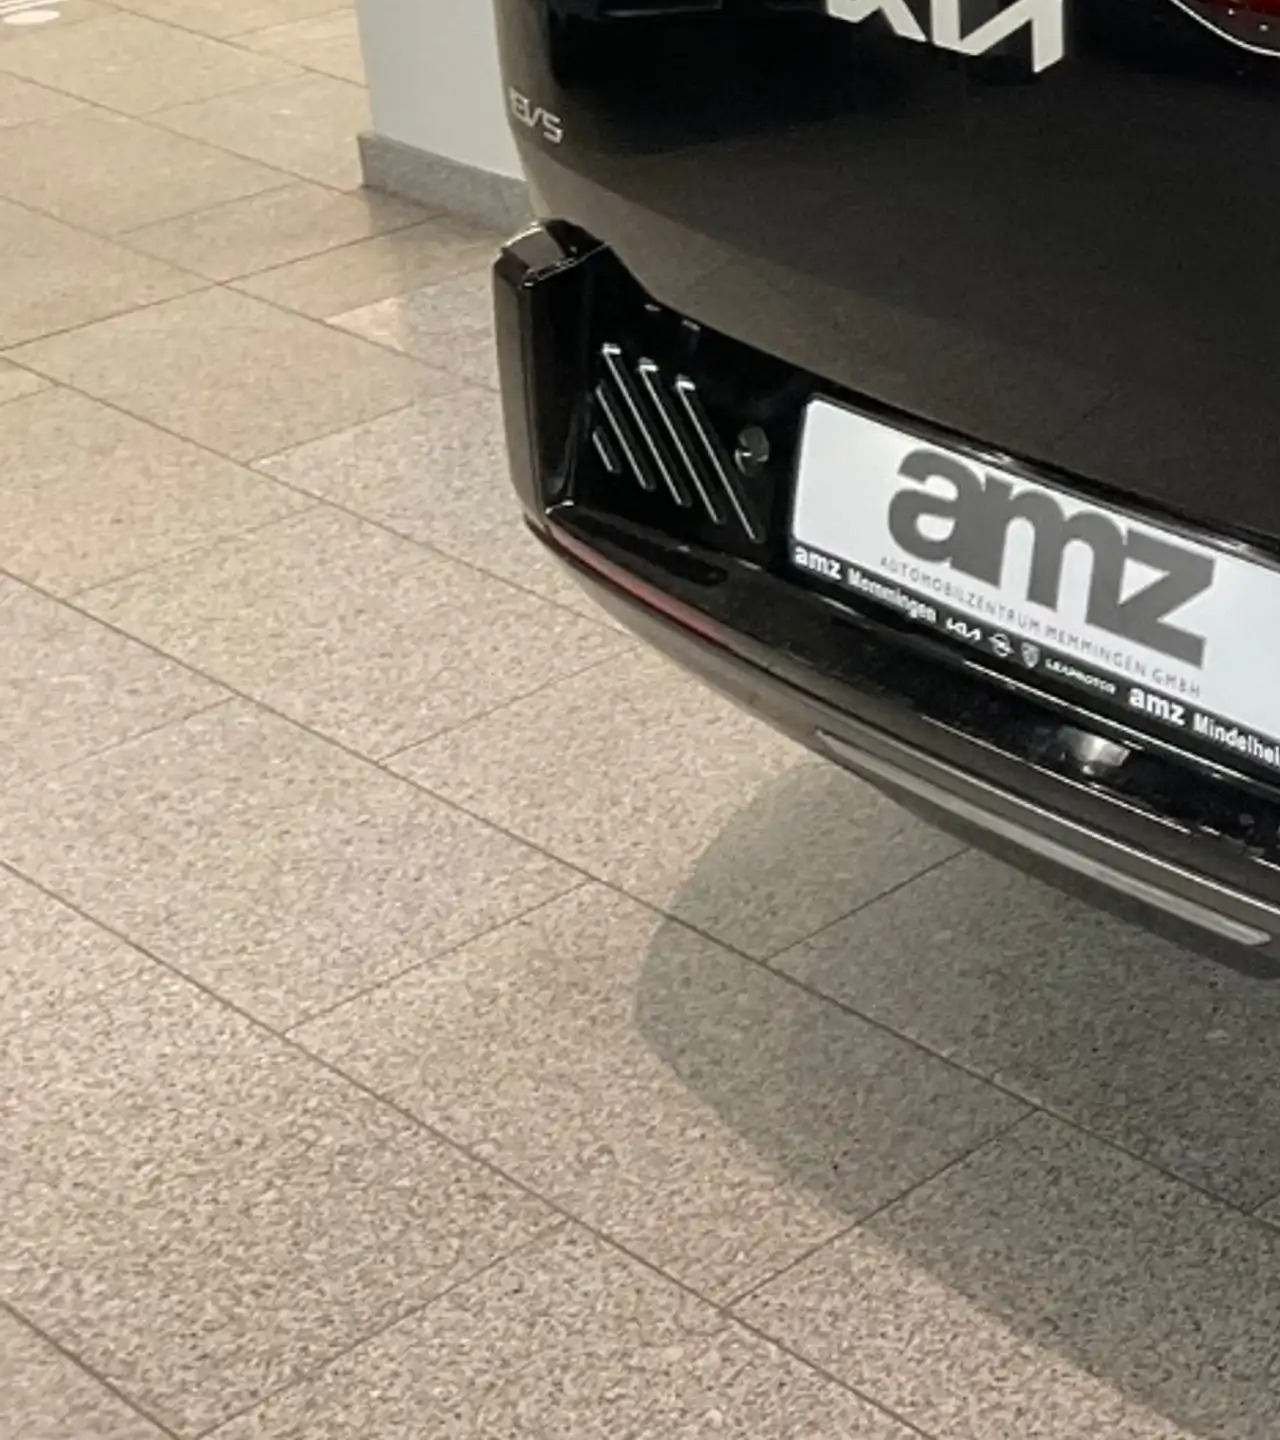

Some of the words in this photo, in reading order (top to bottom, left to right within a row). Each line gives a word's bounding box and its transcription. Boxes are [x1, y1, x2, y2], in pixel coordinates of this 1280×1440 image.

[508, 86, 563, 144] EV5
[879, 555, 1042, 632] AUTOMOBILZENTRUM
[1044, 625, 1147, 676] MEMMINGEN
[888, 448, 1216, 671] amz
[794, 545, 843, 581] amz
[846, 567, 937, 624] Memmingen
[1128, 686, 1186, 726] amz
